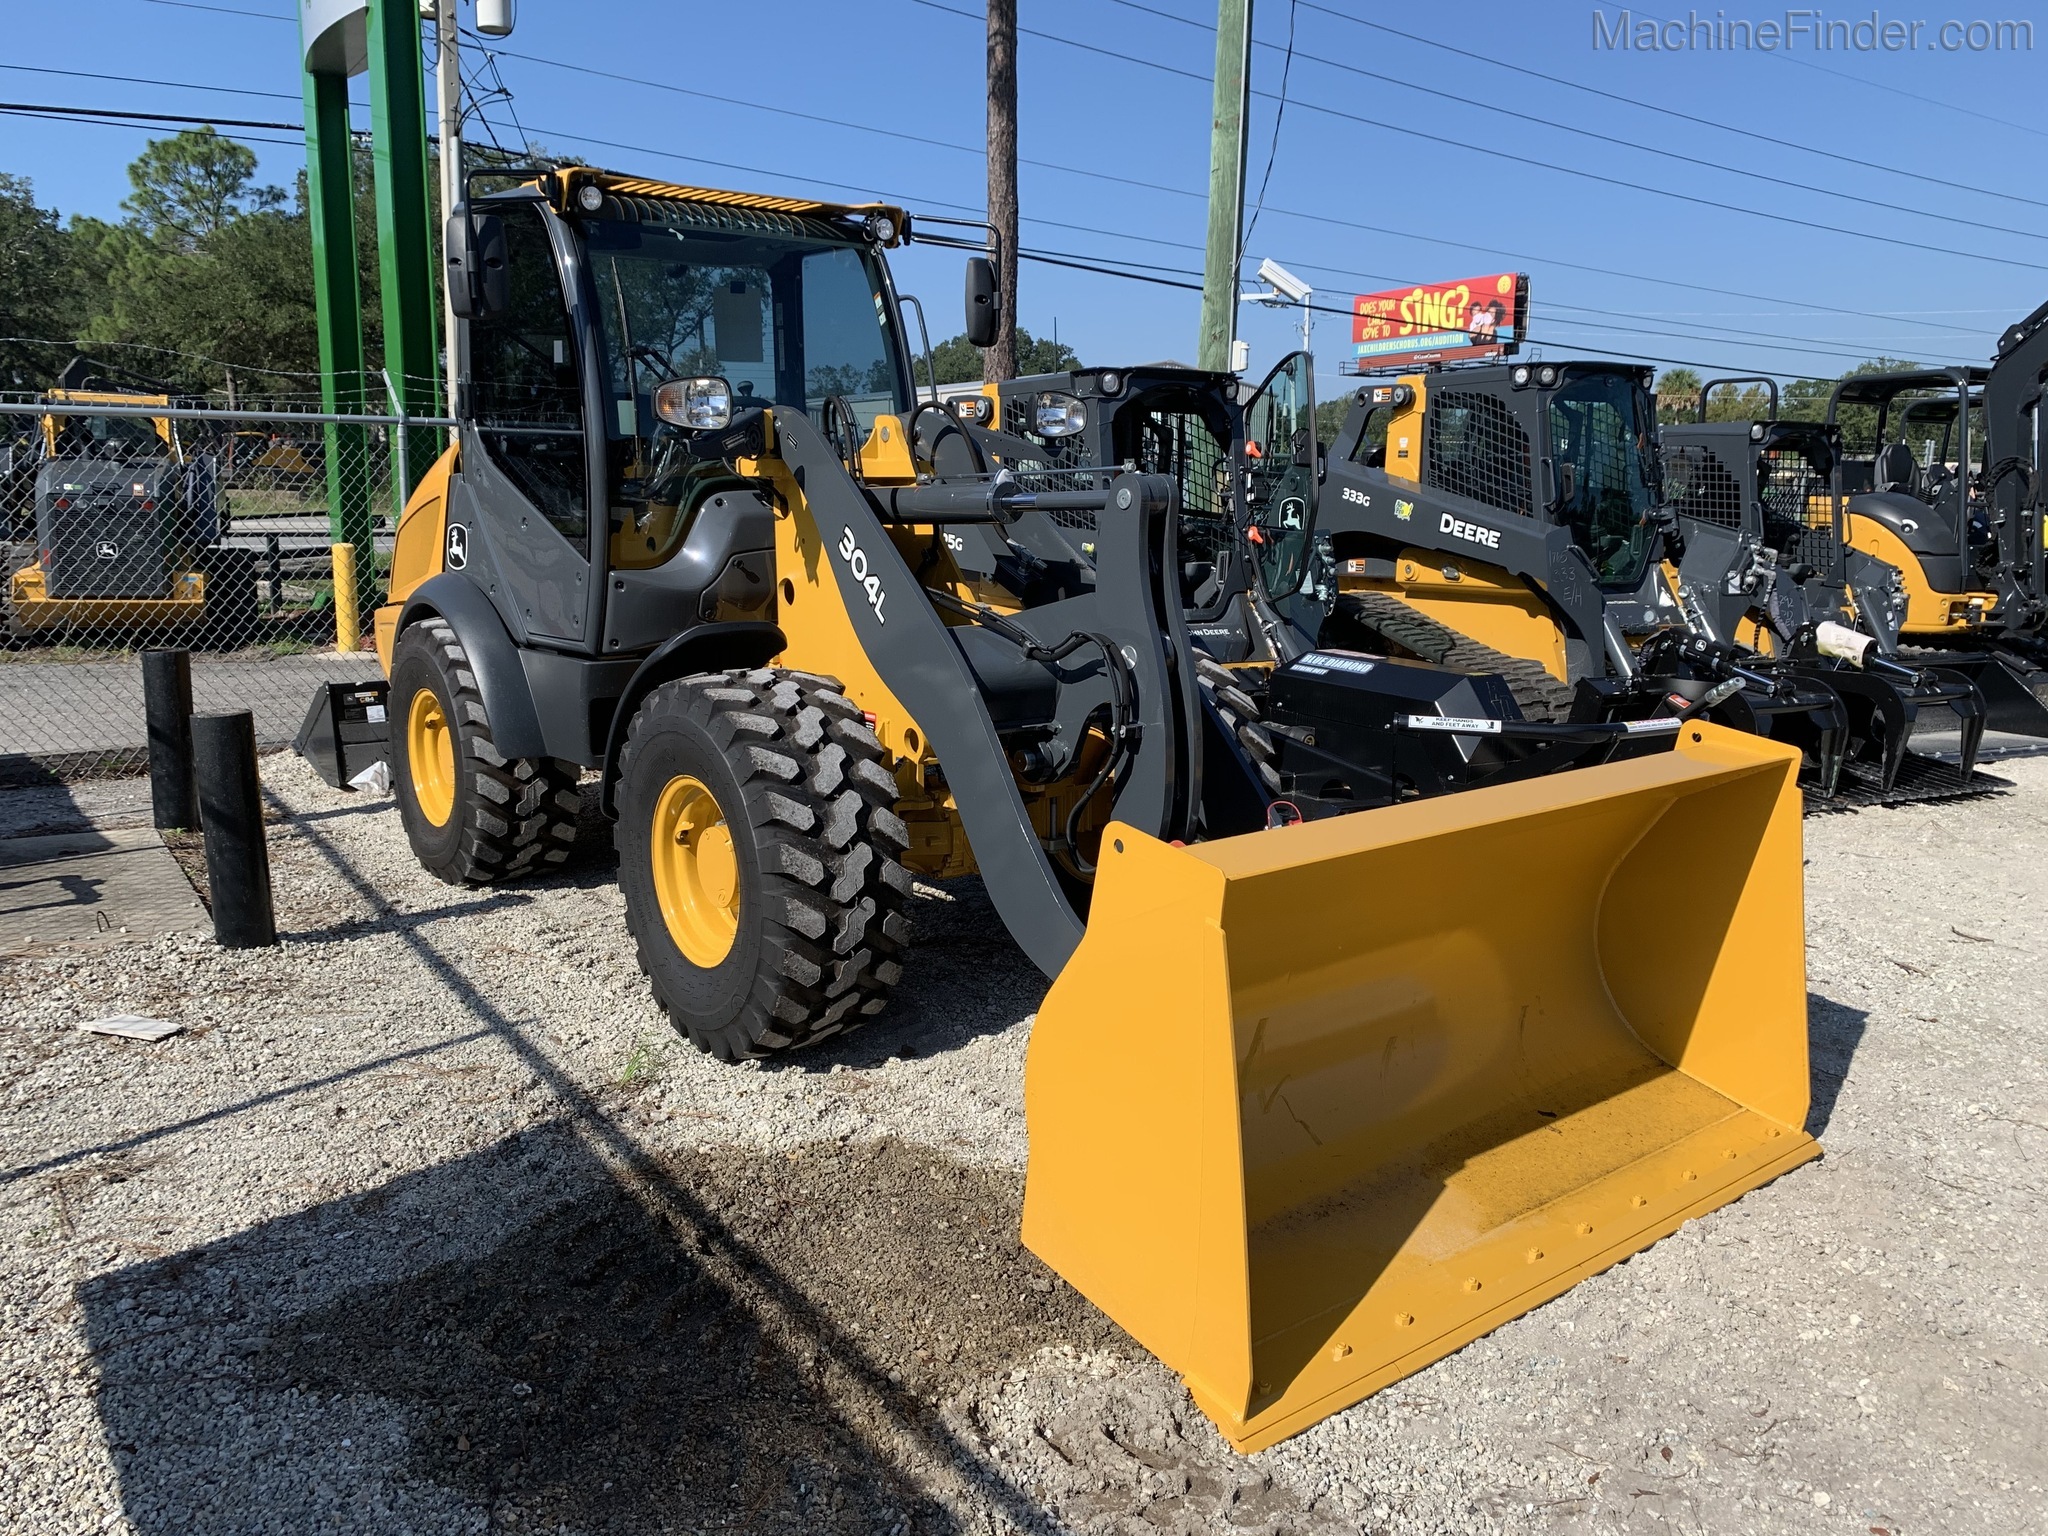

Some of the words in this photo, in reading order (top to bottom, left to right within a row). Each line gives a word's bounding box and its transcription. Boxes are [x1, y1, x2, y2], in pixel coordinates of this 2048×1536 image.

[1360, 301, 1377, 315] DOES
[1378, 299, 1396, 312] YOUR
[1367, 312, 1387, 327] CHILD
[1382, 324, 1391, 338] TO
[1357, 333, 1464, 355] JAXCHILDRENSCHORUS.ORG/AUDITION
[1341, 487, 1371, 507] 333G
[1439, 512, 1501, 549] DEERE
[838, 524, 886, 626] 304L
[1203, 628, 1230, 636] DEERE
[1301, 654, 1329, 666] BLUE
[1328, 657, 1373, 673] DIAMOND
